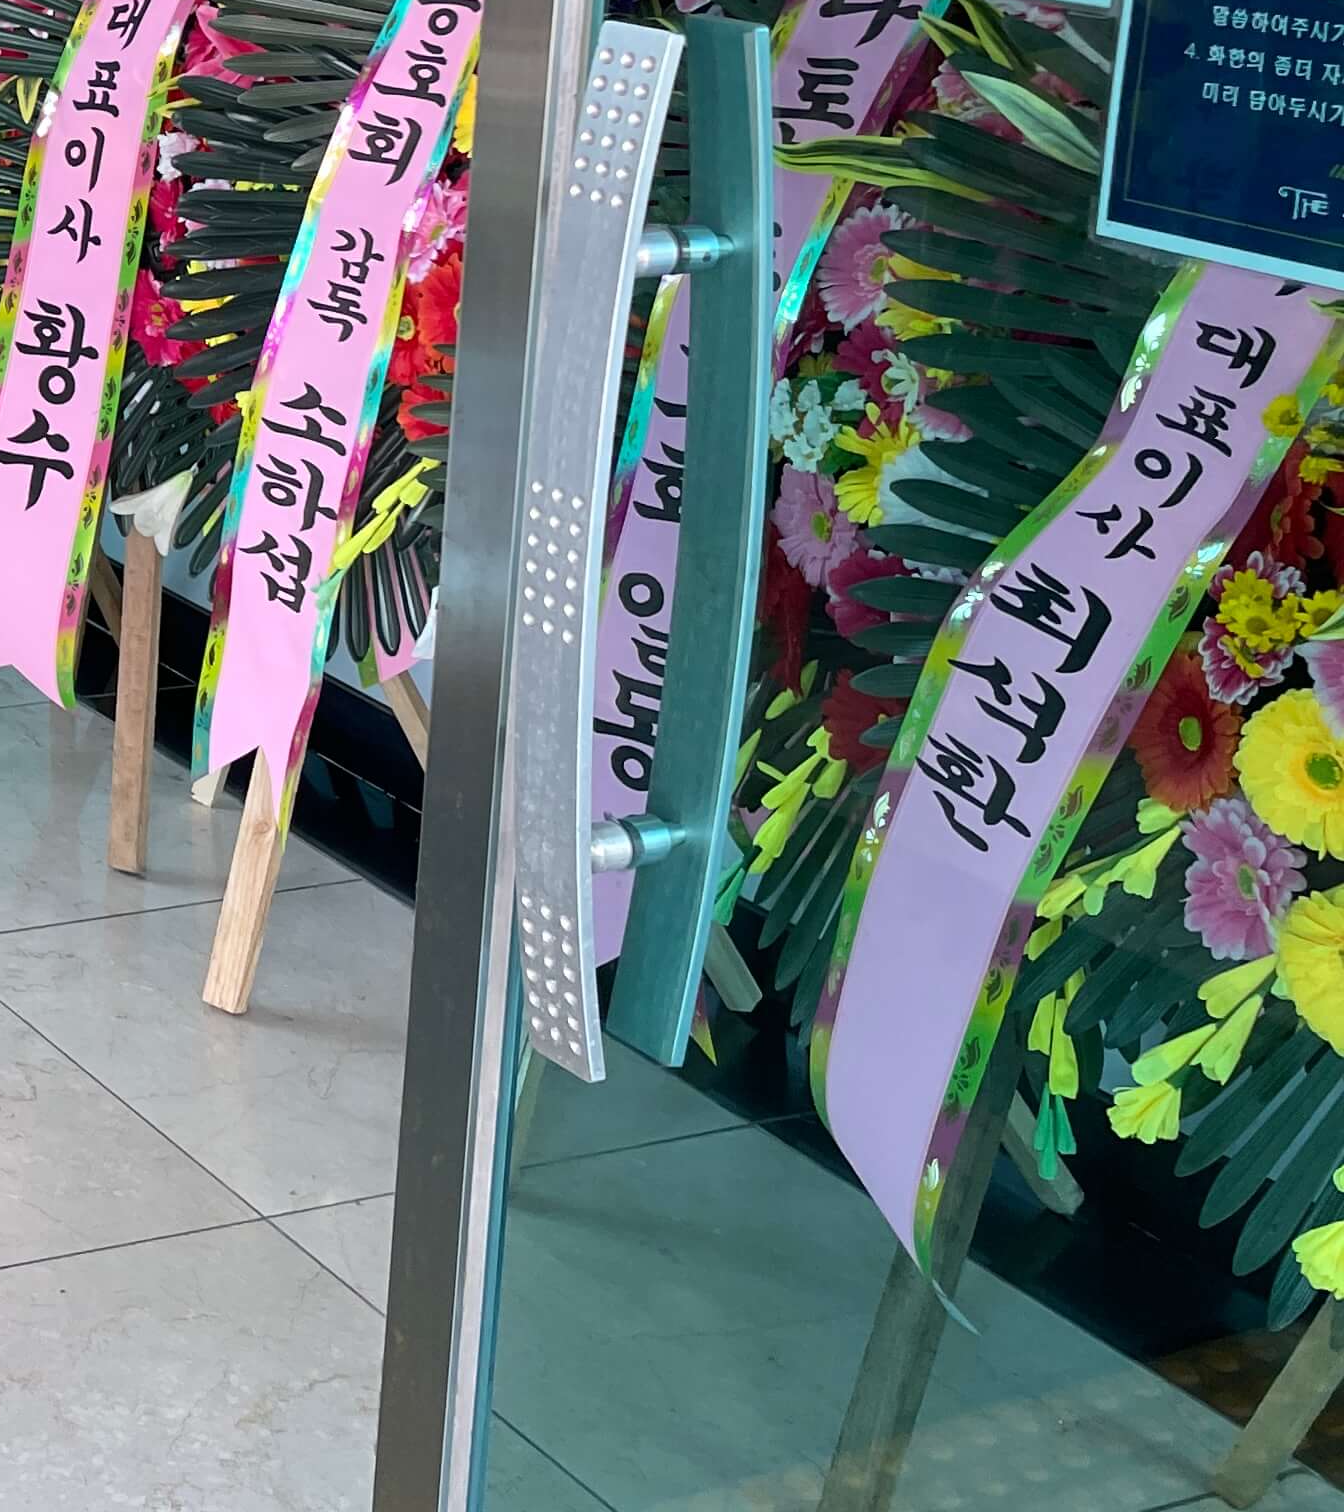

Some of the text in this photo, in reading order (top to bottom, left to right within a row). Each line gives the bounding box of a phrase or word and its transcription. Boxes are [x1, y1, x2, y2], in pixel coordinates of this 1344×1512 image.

[1201, 81, 1241, 107] 미리
[305, 226, 386, 344] 감독
[238, 380, 349, 615] 소하섭
[915, 319, 1278, 853] 대표이사 최석환
